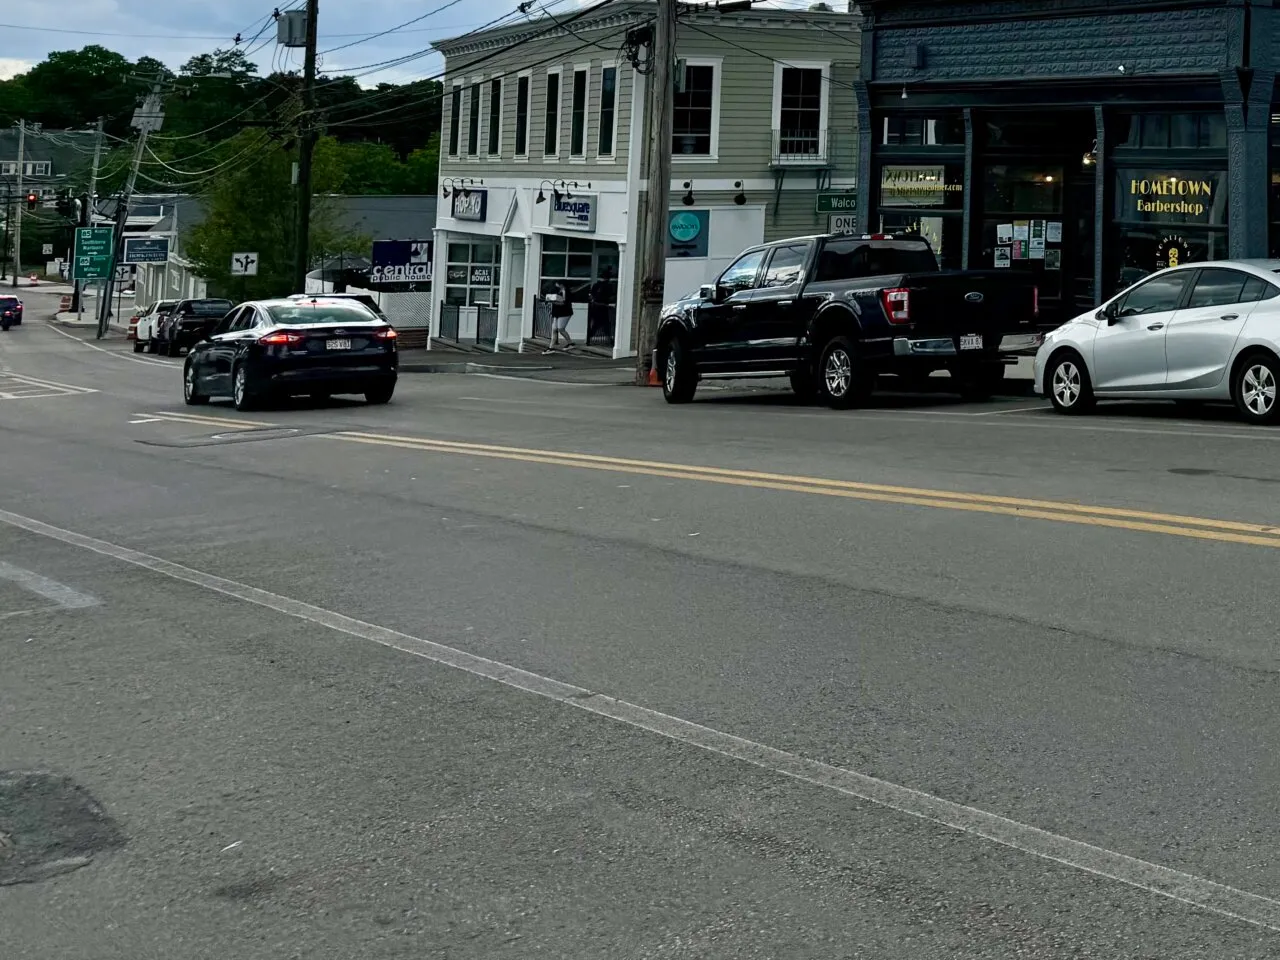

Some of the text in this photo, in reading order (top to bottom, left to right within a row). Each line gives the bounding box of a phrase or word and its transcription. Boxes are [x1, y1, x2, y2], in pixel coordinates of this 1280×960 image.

[1131, 179, 1212, 196] HOMETOWN
[1137, 200, 1203, 216] Barbershop
[835, 218, 857, 228] ONE
[373, 261, 432, 275] central
